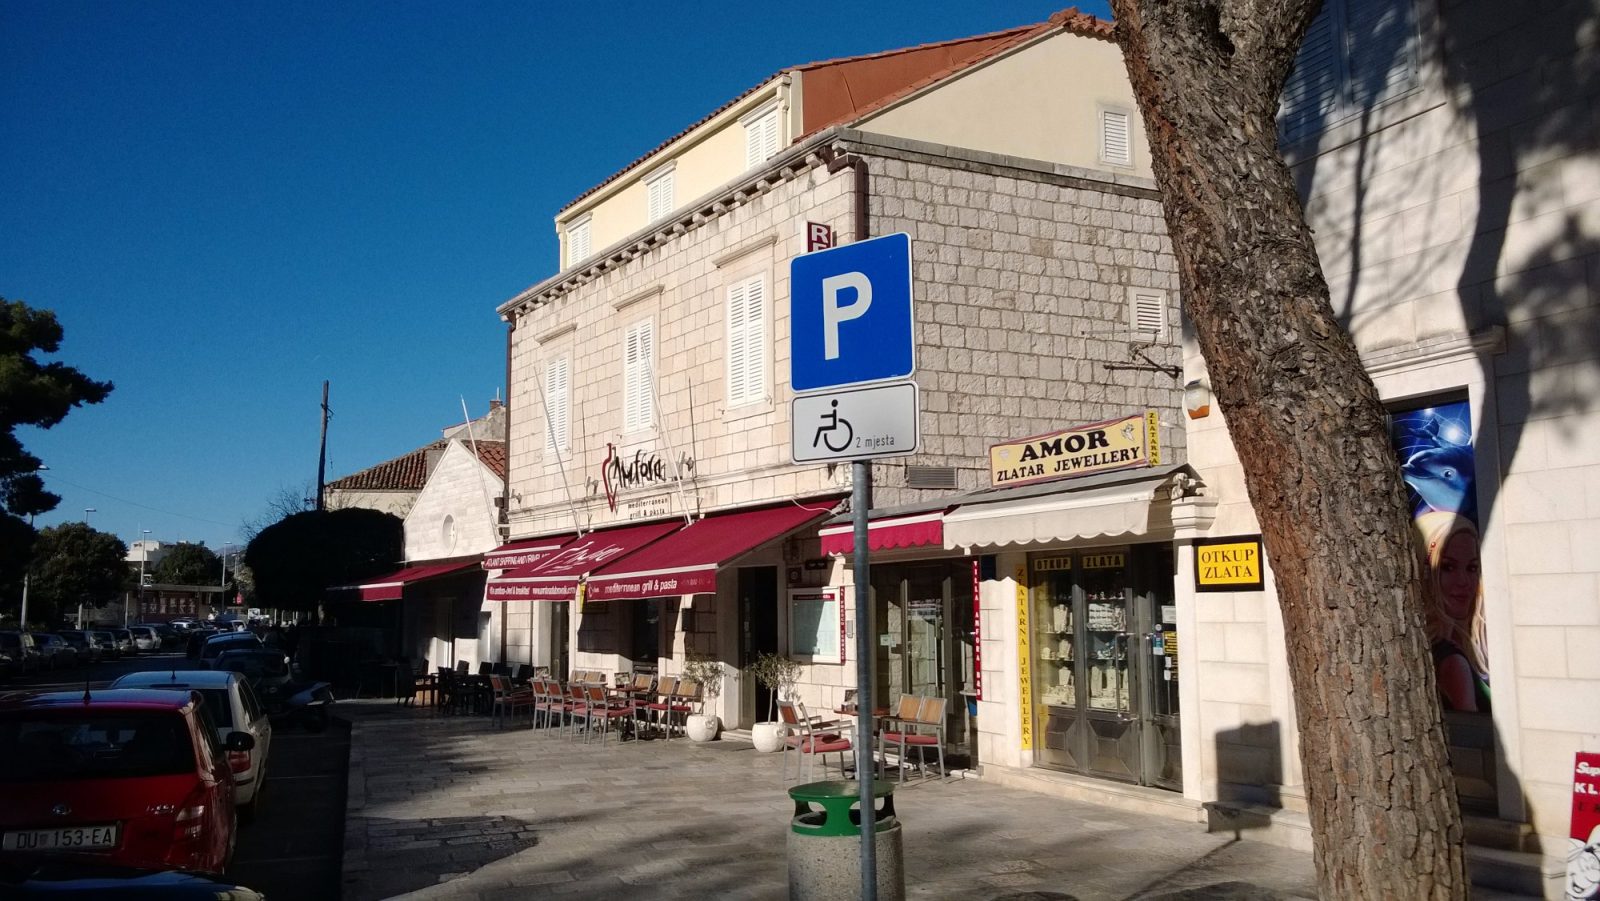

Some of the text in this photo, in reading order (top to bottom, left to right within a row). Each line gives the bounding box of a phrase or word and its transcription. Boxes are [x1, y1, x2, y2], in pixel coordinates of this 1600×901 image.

[822, 271, 873, 361] P
[856, 434, 895, 450] 2 mjesta
[1019, 430, 1110, 462] AMOR
[1149, 412, 1158, 465] ZLATARNA
[997, 446, 1141, 482] ZLATAR JEWELLERY
[628, 498, 668, 509] mediterranean
[1037, 555, 1121, 570] OTKUP ZLATA
[1201, 549, 1254, 564] OTKUP
[1203, 564, 1253, 579] ZLATA
[642, 579, 653, 594] grill
[653, 579, 659, 590] &
[660, 578, 678, 592] pasta
[1017, 568, 1030, 745] ZLATARNA JEWELLERY
[17, 831, 38, 849] DU
